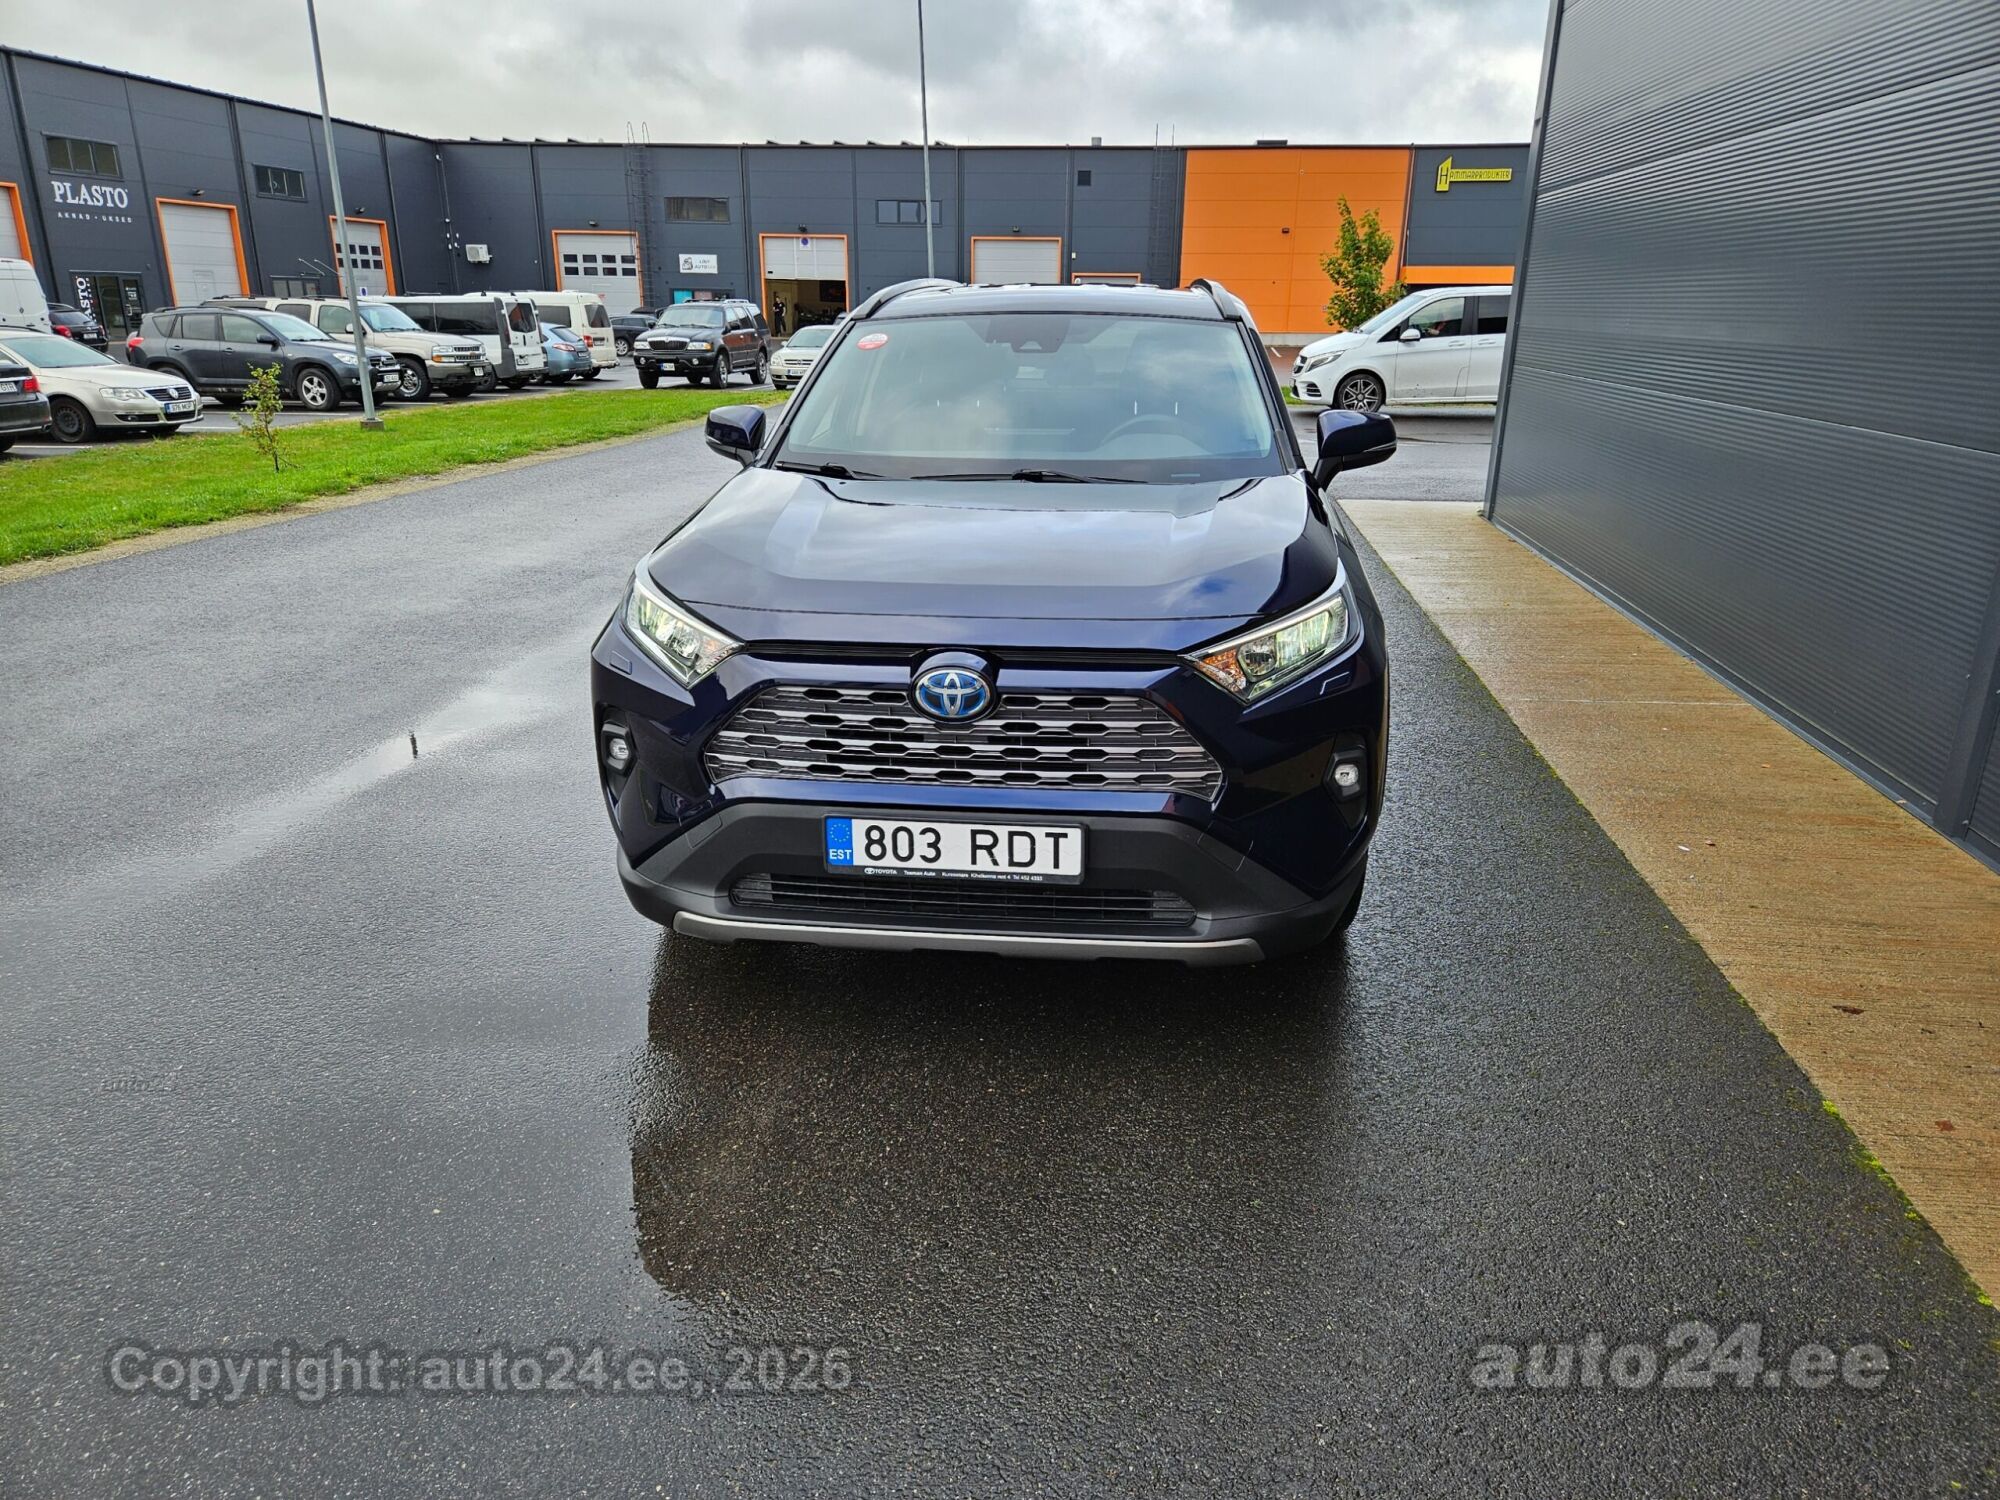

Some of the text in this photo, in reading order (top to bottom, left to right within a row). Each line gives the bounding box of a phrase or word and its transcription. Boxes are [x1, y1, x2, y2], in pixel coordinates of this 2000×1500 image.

[51, 181, 129, 208] PLASTO
[57, 211, 133, 223] AKNAD UKSED
[829, 849, 852, 860] EST
[864, 824, 1068, 870] 803 RDT
